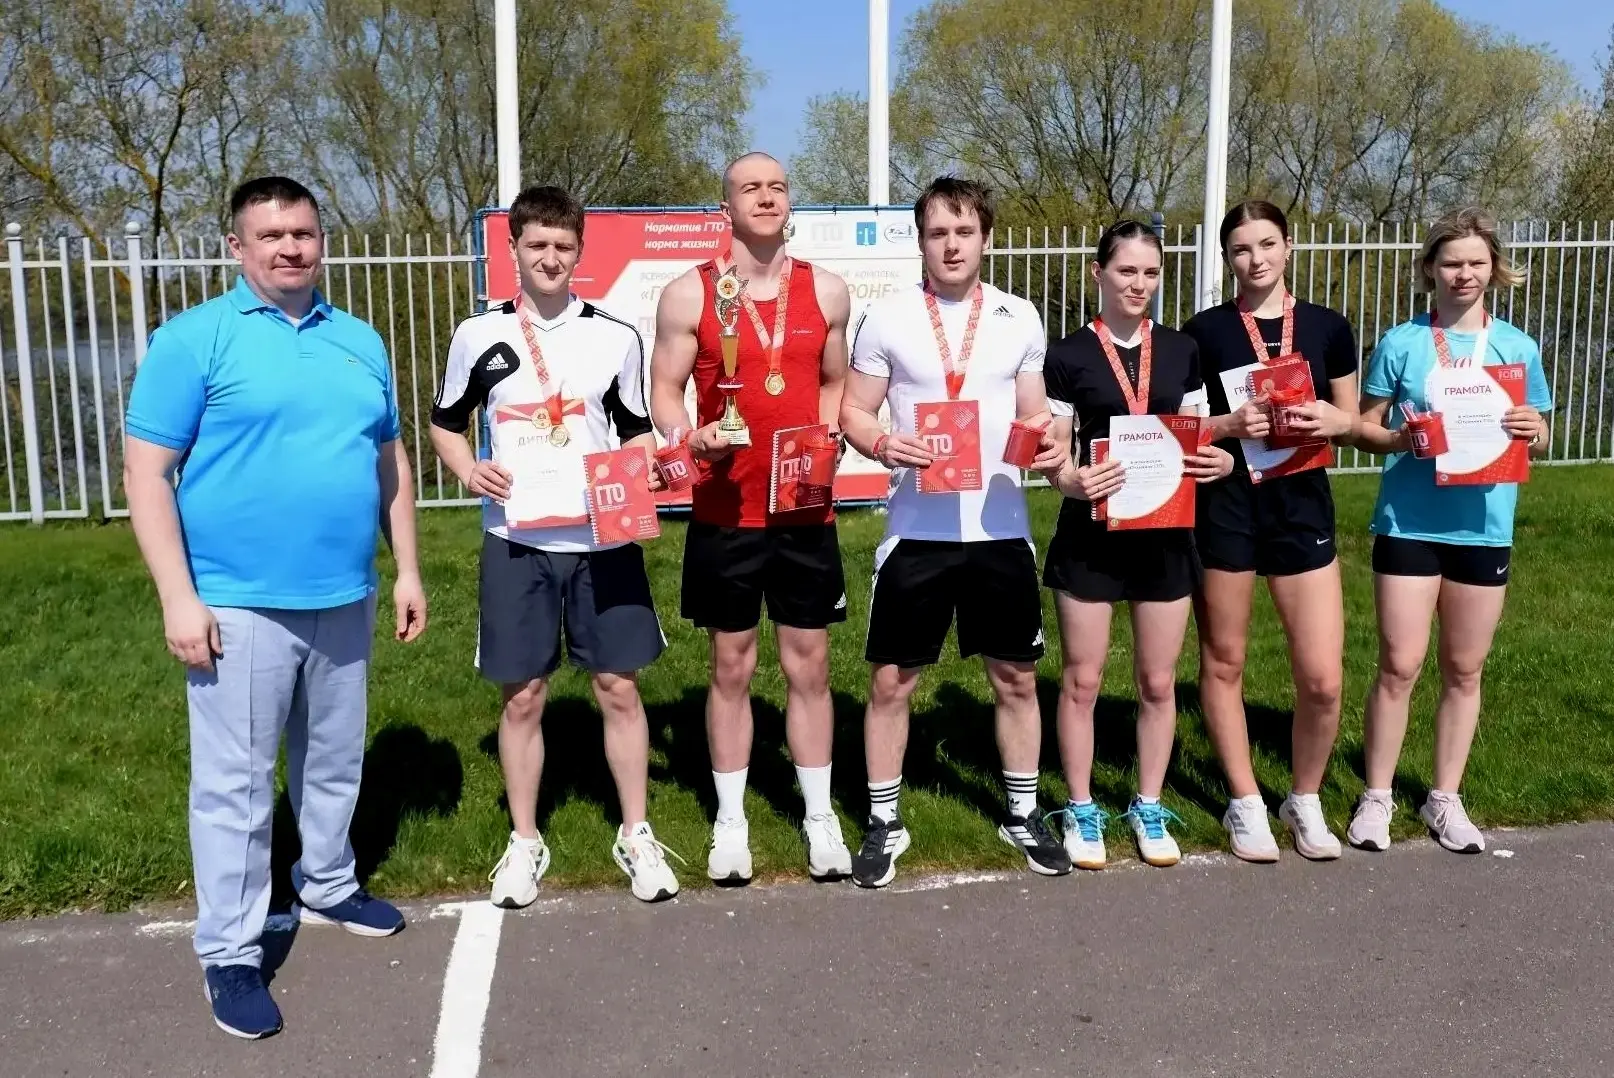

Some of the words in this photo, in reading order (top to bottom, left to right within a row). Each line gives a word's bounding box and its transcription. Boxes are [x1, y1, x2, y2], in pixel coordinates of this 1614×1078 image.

[644, 222, 702, 234] Норматив
[703, 221, 725, 232] ГТО
[644, 240, 679, 251] норма
[680, 239, 719, 249] жизни!
[486, 363, 508, 371] adidas
[1234, 385, 1250, 395] ГРА
[1444, 385, 1492, 396] ГРАМОТА
[518, 436, 549, 447] ДИПЛ
[1118, 432, 1164, 442] ГРАМОТА
[594, 482, 625, 507] ГТО
